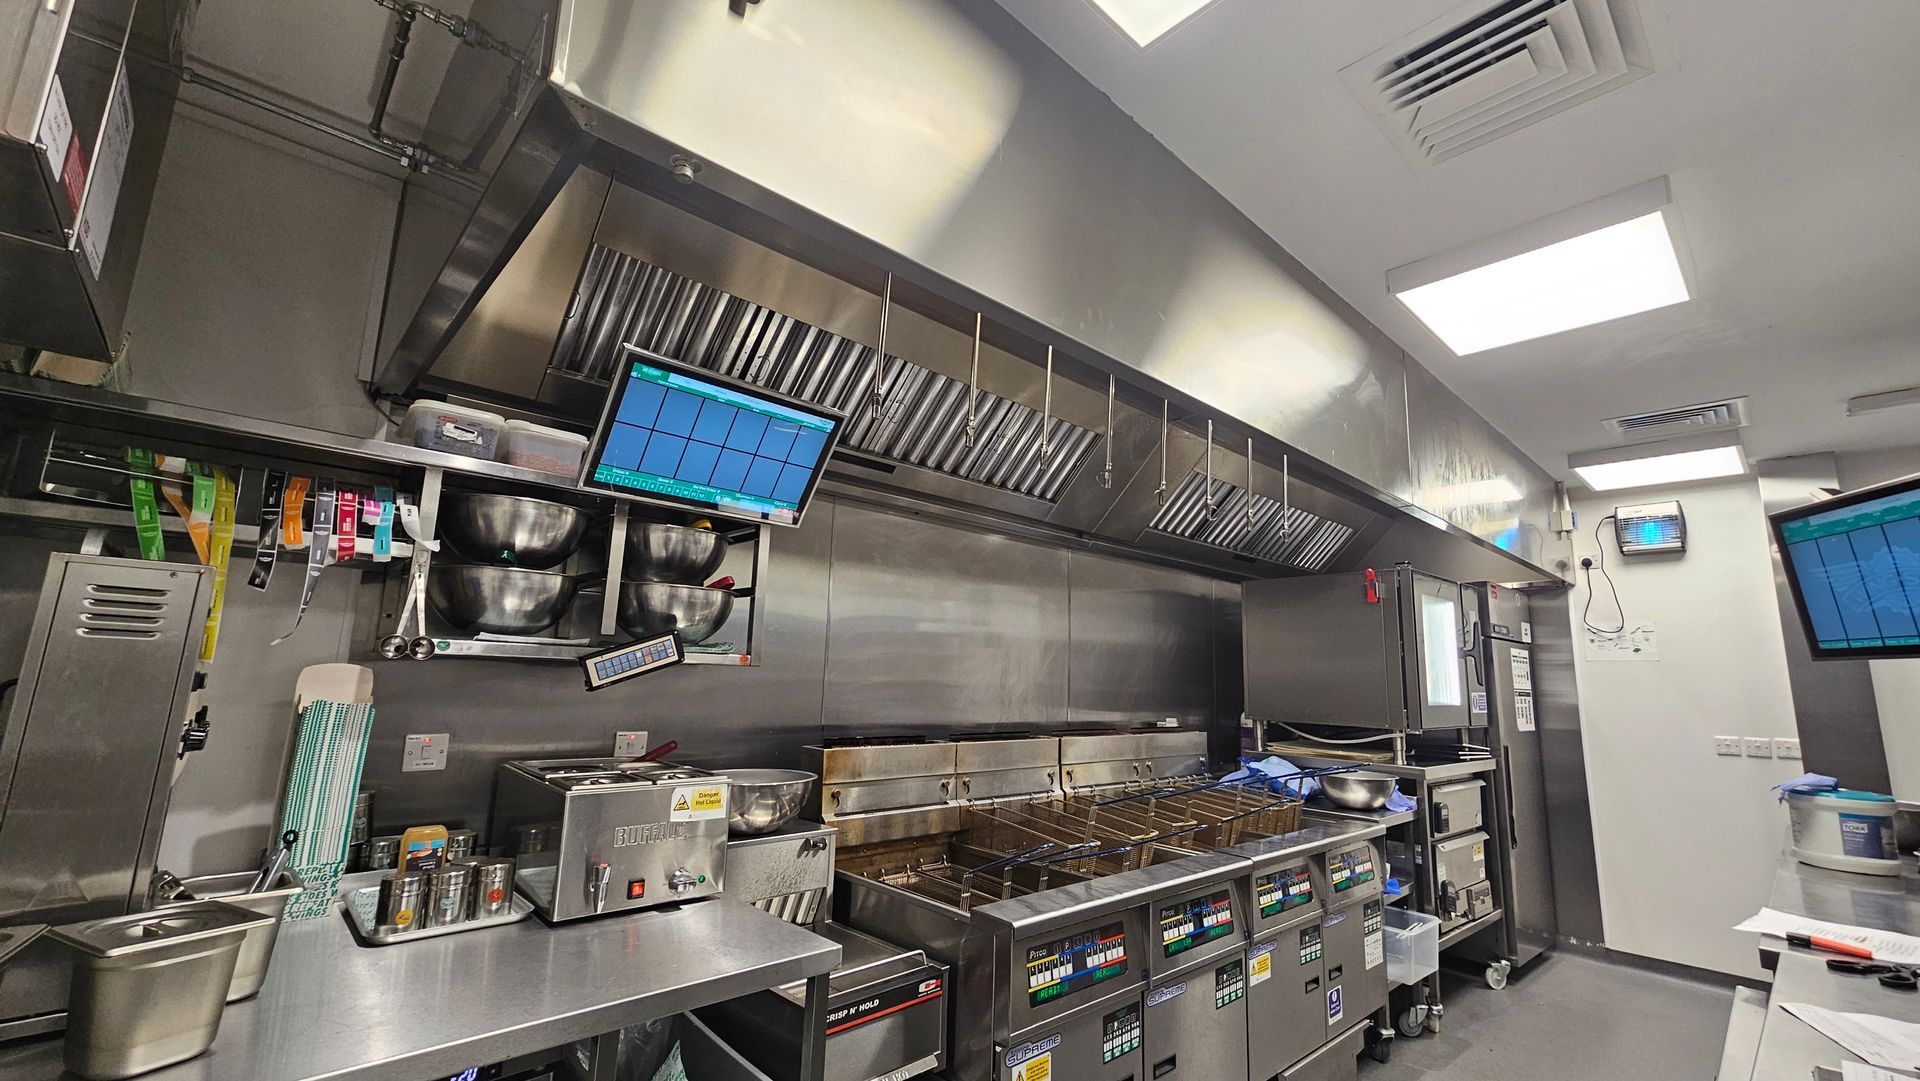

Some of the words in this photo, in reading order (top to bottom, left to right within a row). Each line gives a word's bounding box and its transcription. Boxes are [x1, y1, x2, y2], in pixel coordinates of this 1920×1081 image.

[699, 791, 719, 799] Danger
[706, 798, 721, 806] Liquid
[1844, 824, 1867, 832] TORK
[614, 822, 688, 848] BUFFALO
[859, 999, 880, 1013] HOLD
[1008, 1034, 1060, 1064] SUPREME
